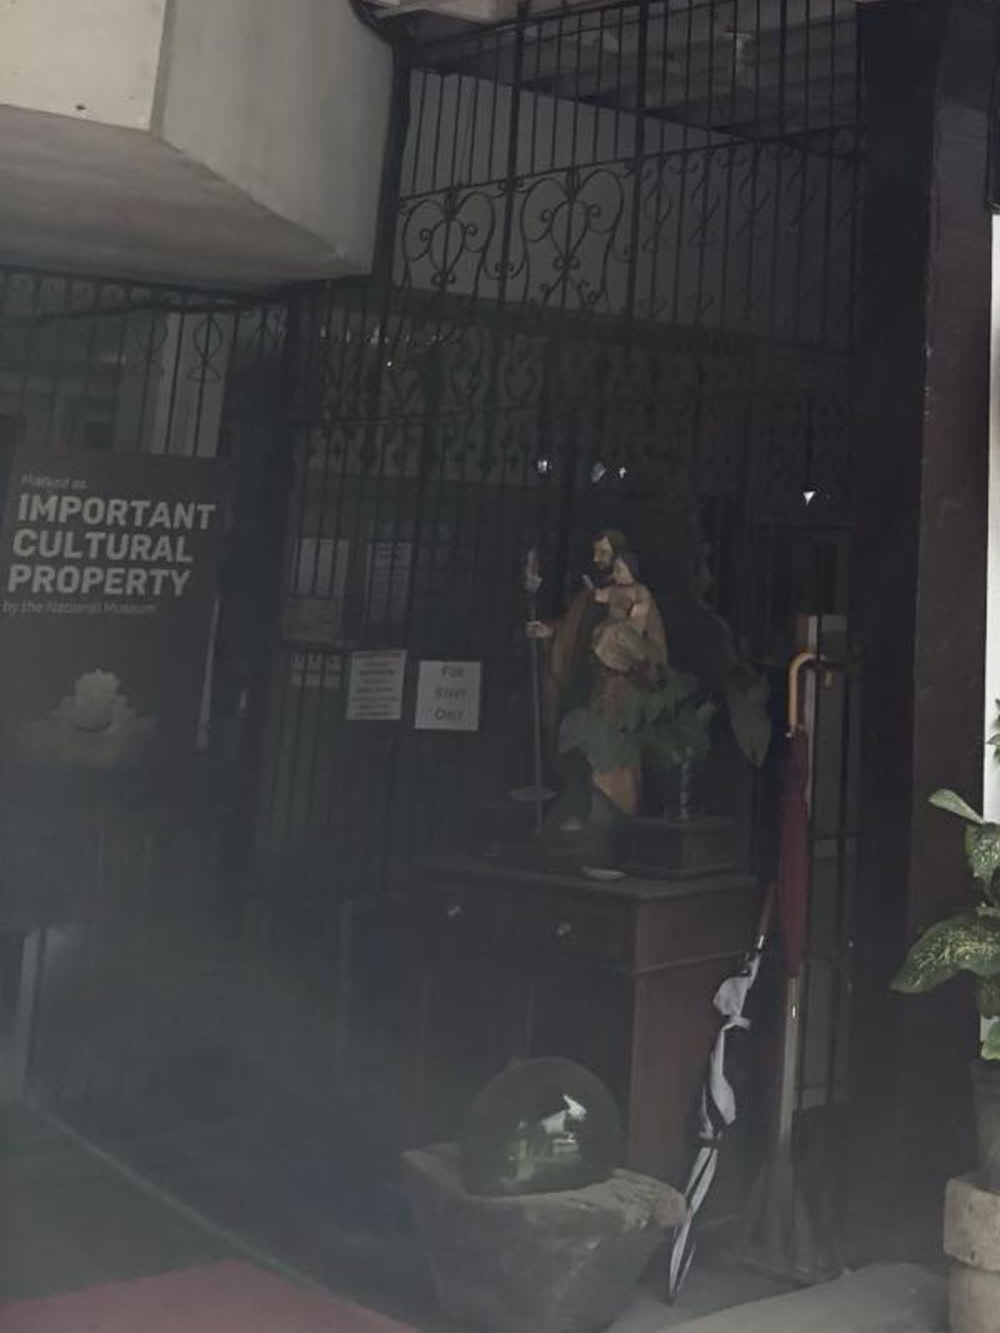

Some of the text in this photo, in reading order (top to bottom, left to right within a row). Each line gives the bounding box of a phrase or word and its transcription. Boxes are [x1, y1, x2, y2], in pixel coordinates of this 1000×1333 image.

[18, 492, 216, 530] IMPORTANT
[13, 527, 193, 563] CULTURAL
[8, 563, 192, 597] PROPERTY
[2, 599, 157, 617] by the National Museum
